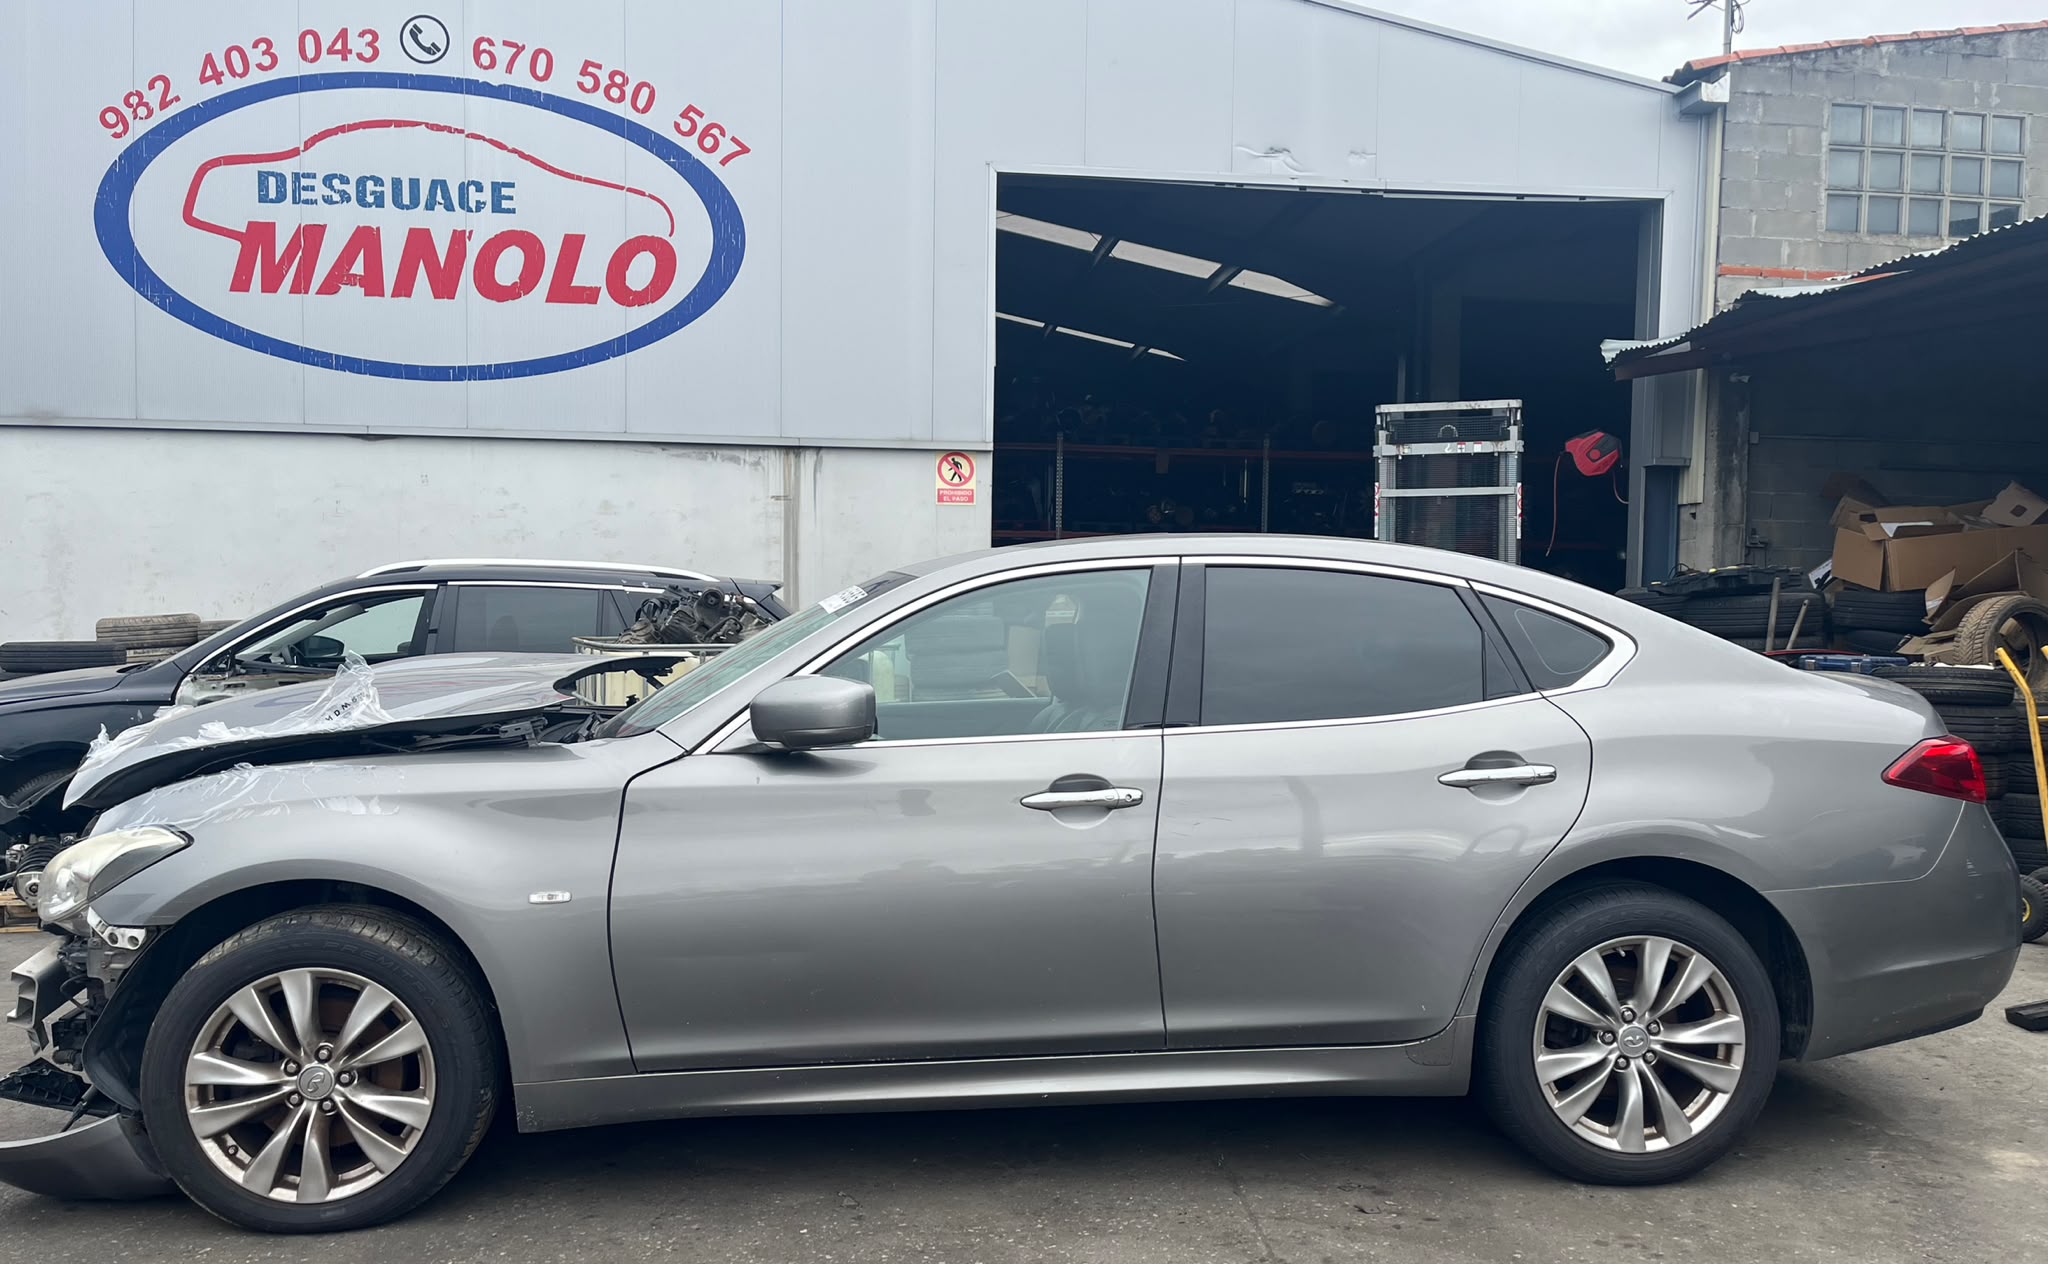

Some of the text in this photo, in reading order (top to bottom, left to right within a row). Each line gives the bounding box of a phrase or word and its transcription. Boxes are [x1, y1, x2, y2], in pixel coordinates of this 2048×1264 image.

[99, 28, 380, 140] 982 403 043
[471, 36, 752, 169] 670 580 567
[256, 170, 517, 215] DESGUACE
[228, 220, 678, 307] MANOLO
